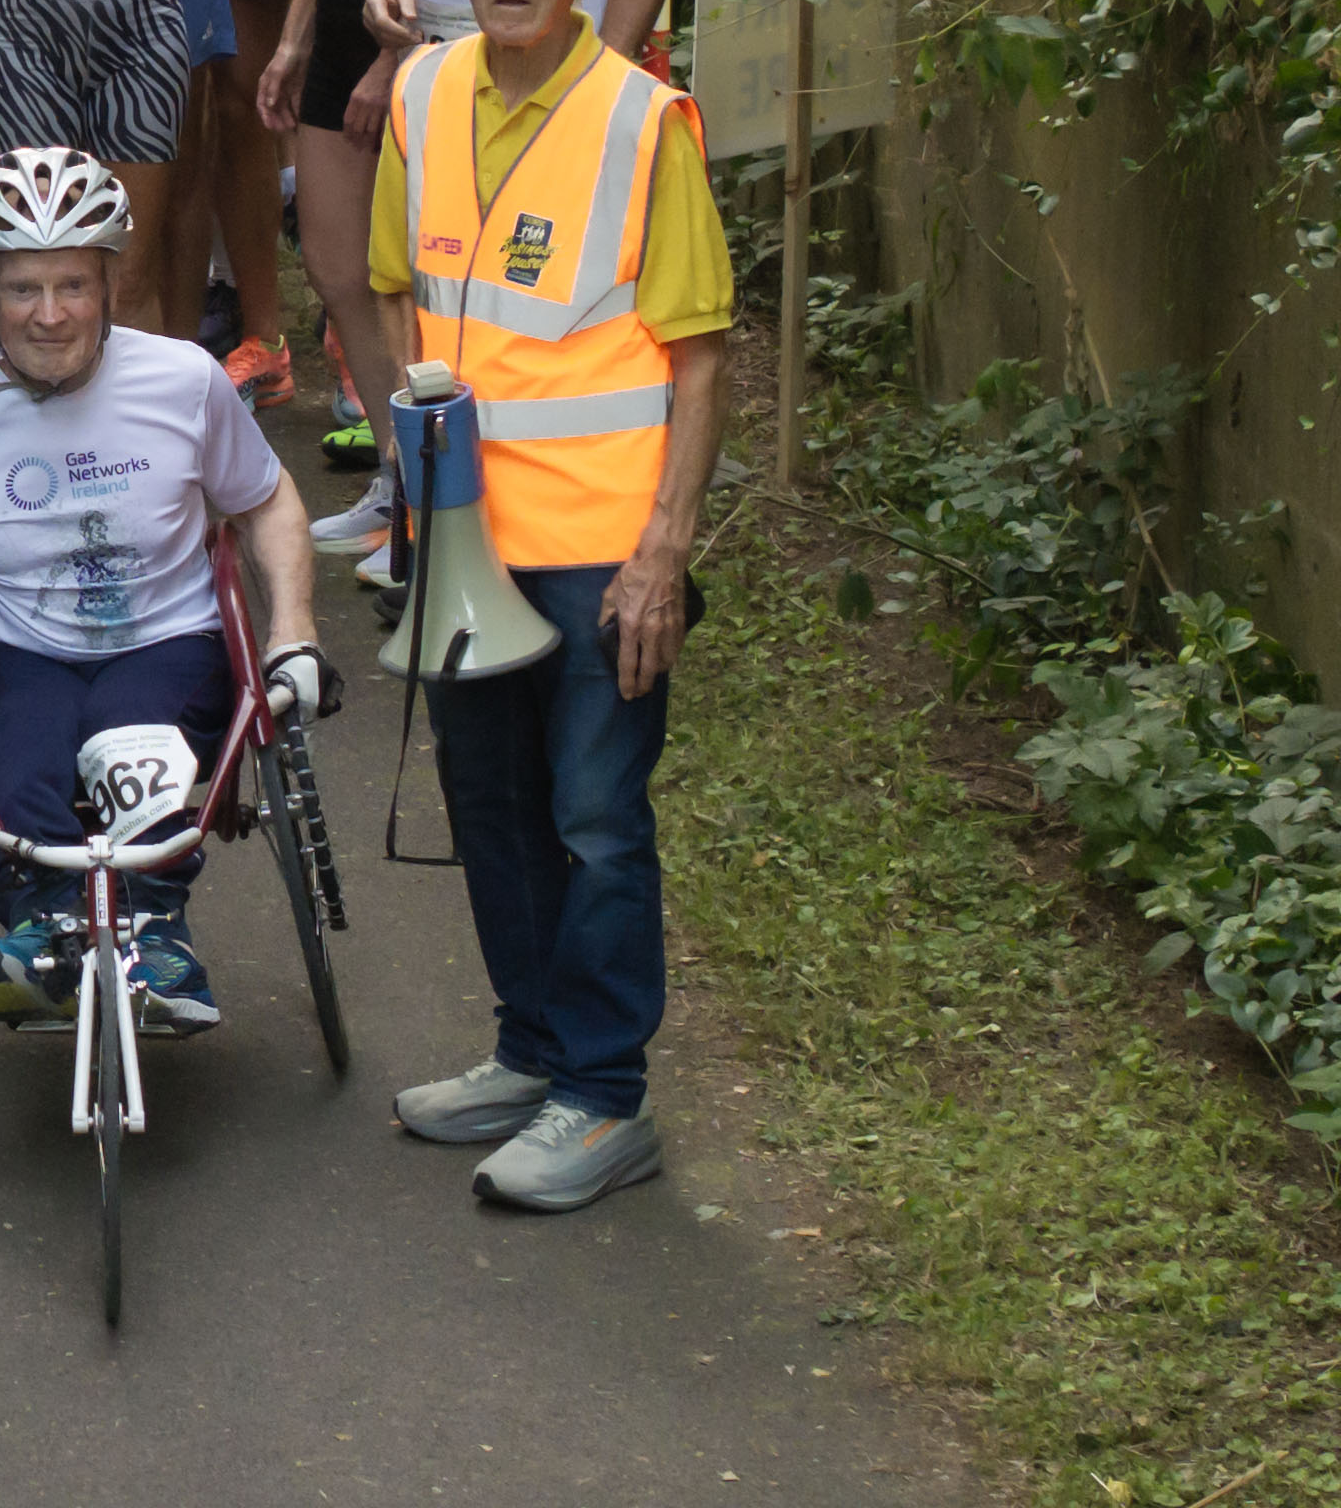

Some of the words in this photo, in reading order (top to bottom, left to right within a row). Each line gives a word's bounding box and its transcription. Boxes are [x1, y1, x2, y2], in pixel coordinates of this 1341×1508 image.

[65, 451, 97, 467] Gas
[68, 458, 150, 483] Networks
[71, 477, 130, 500] Ireland
[92, 757, 179, 831] 962
[114, 799, 173, 840] rkbhaa.com
